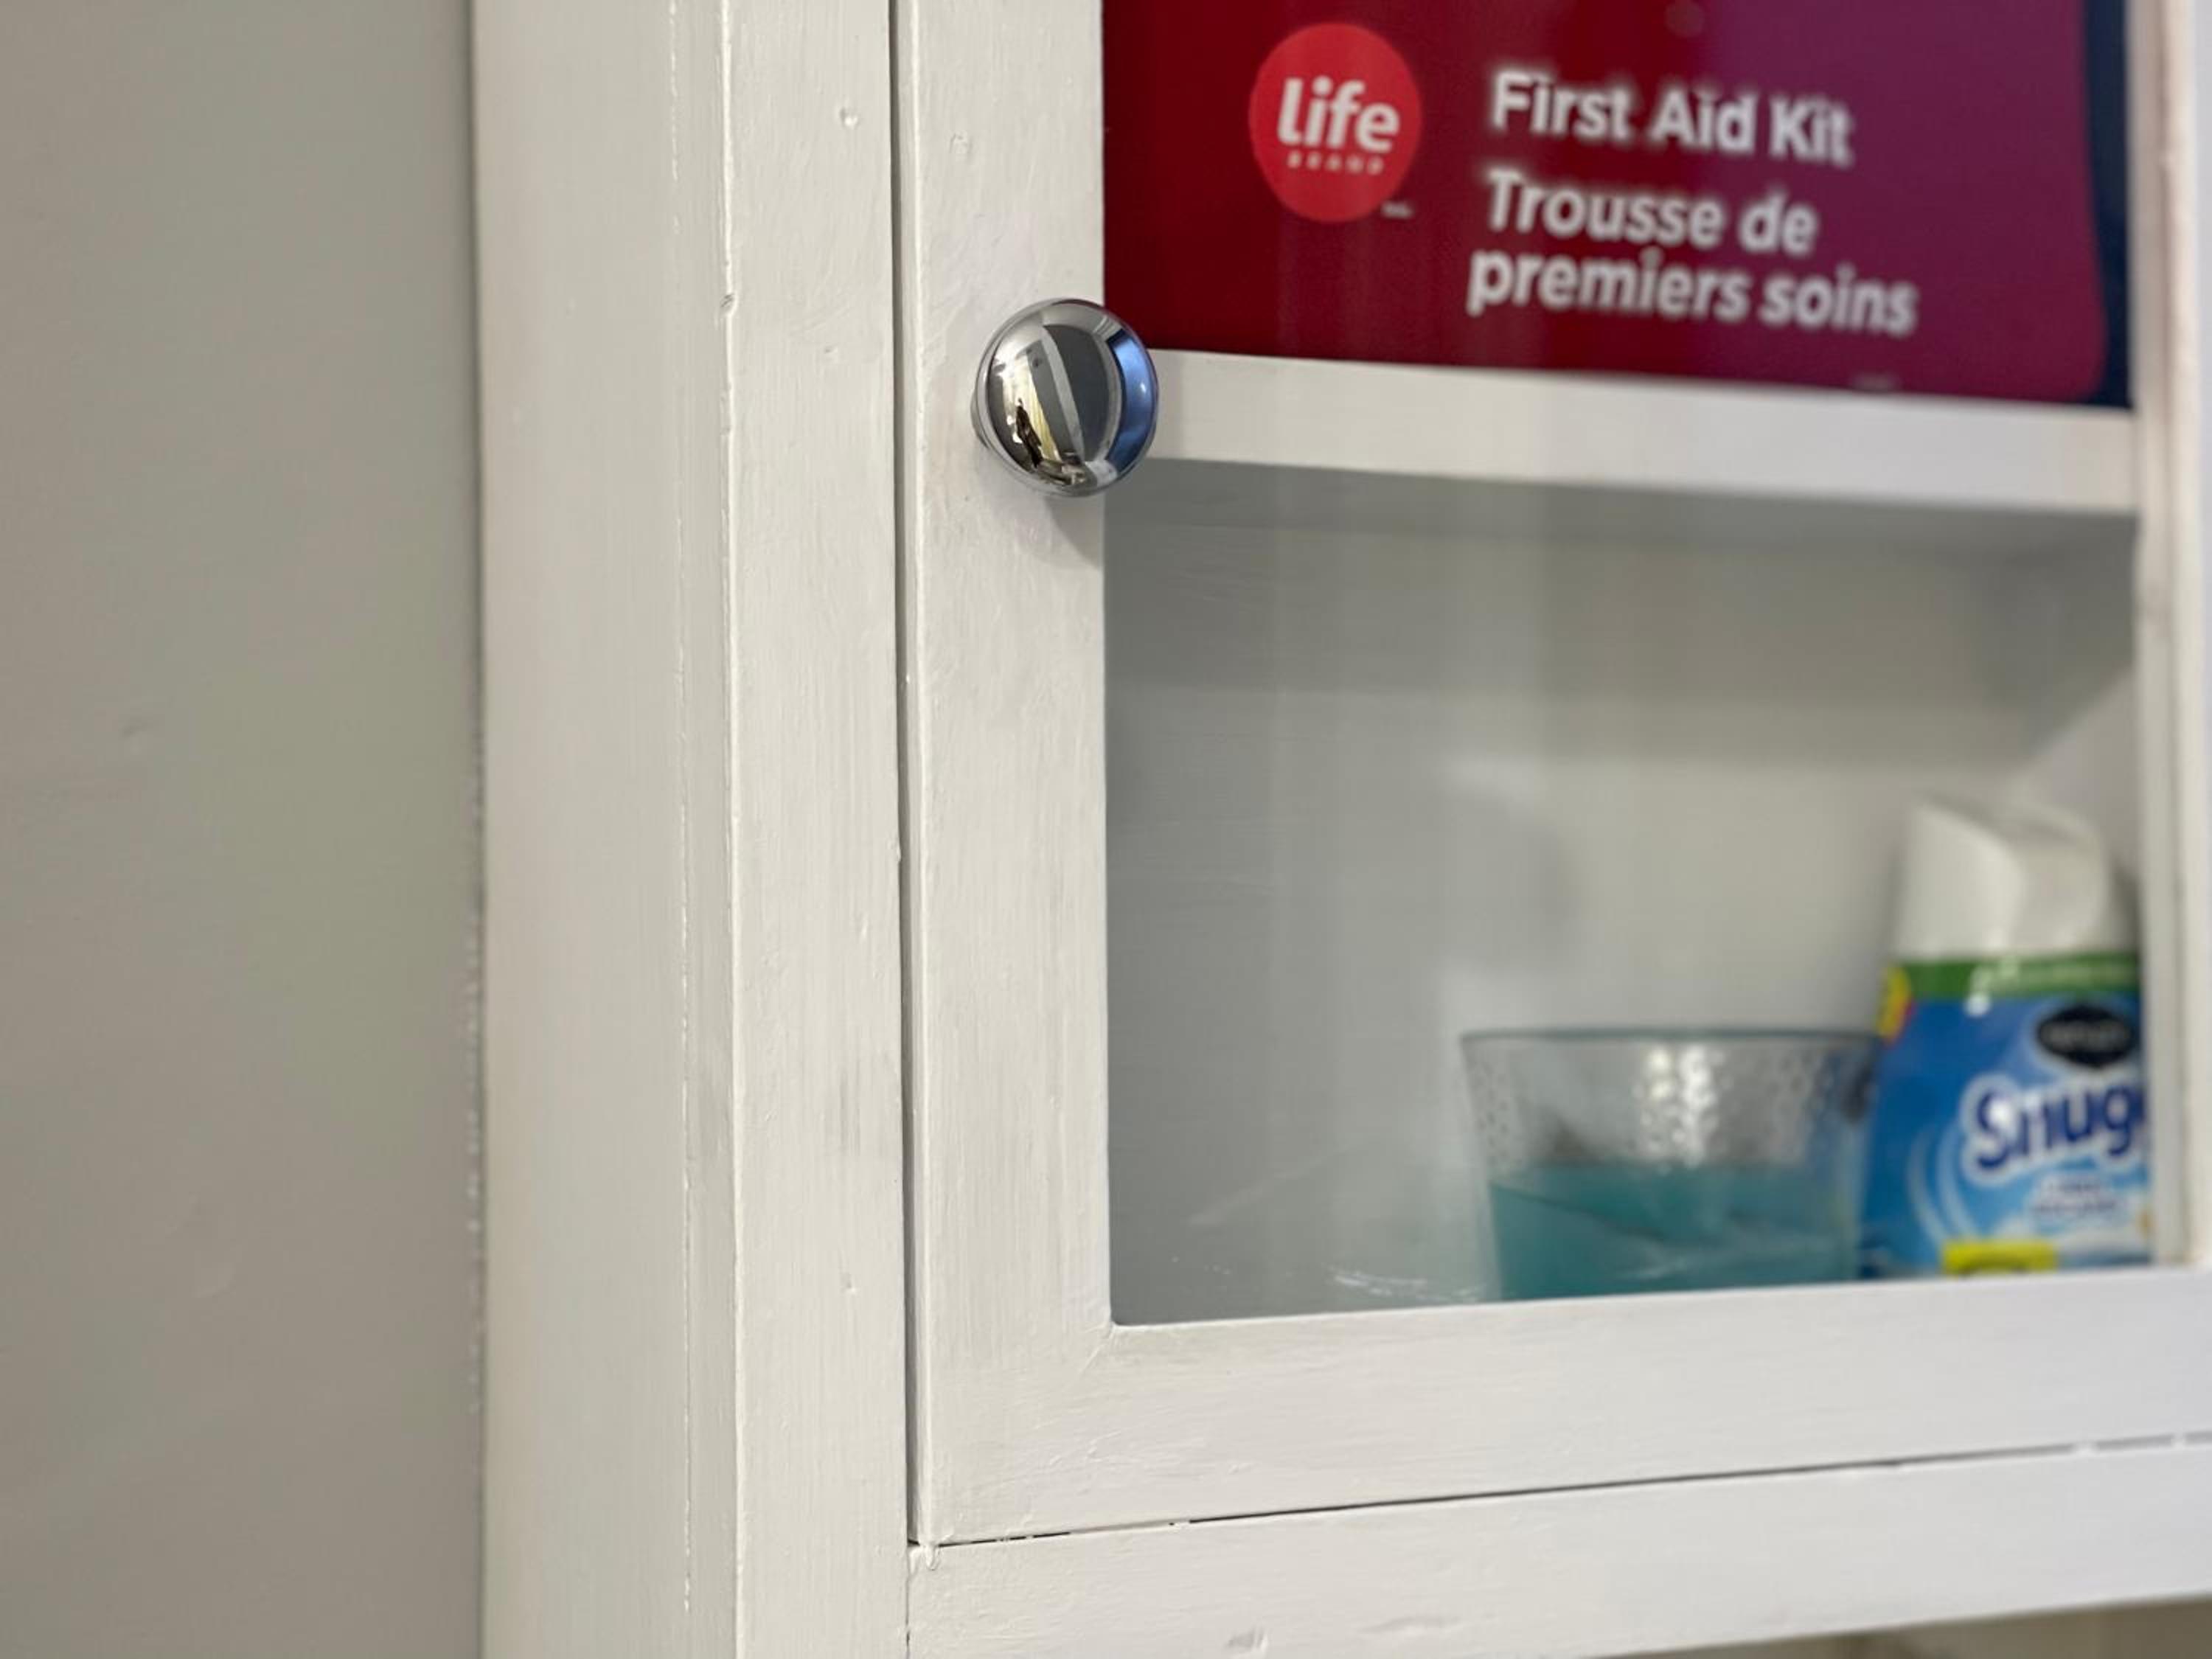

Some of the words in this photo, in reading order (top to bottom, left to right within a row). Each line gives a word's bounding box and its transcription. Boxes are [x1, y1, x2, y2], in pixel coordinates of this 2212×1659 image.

[1491, 69, 1631, 140] First
[1650, 87, 1759, 153] Aid
[1770, 97, 1852, 167] Kit
[1486, 168, 1723, 249] Trousse
[1738, 193, 1818, 256] de
[1466, 249, 1751, 322] premiers
[1761, 265, 1919, 336] soins
[1976, 1085, 2146, 1170] Snug
